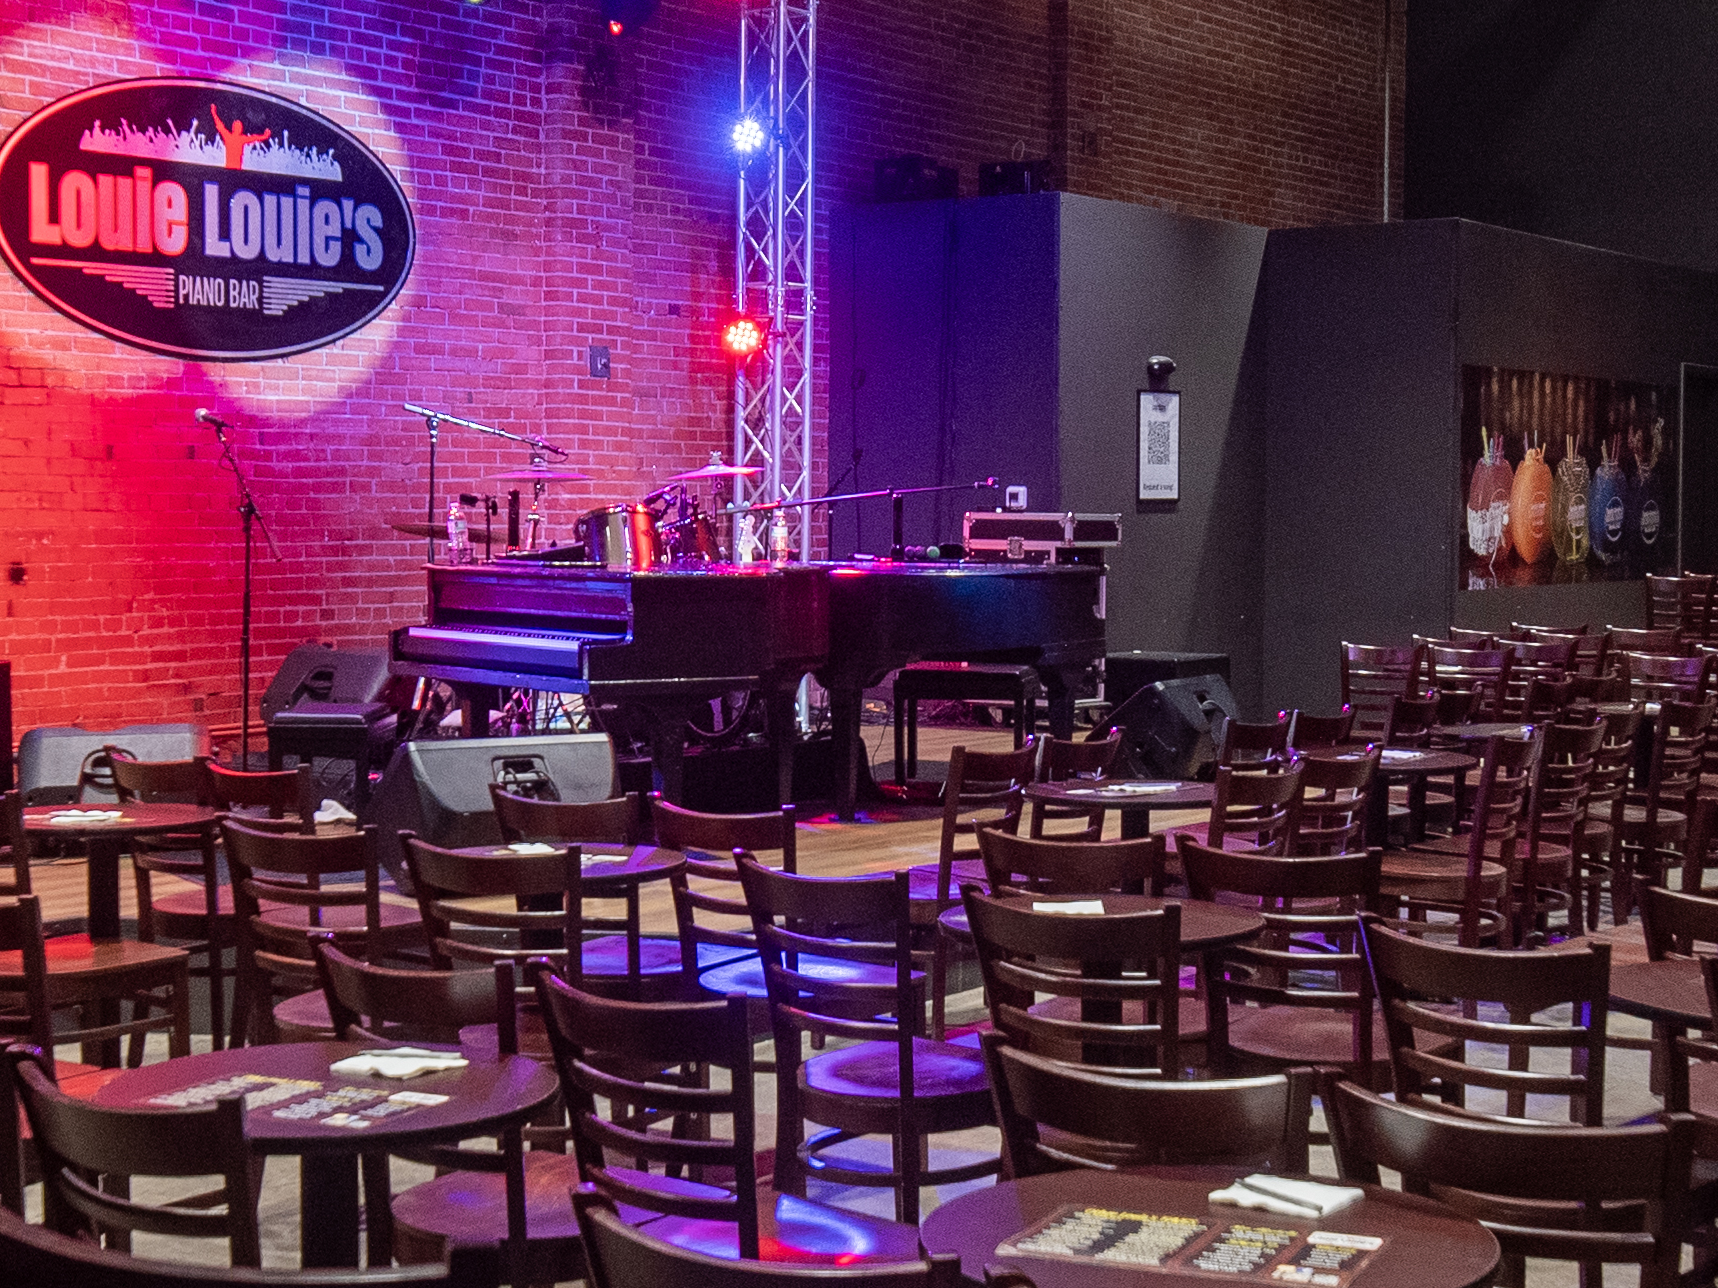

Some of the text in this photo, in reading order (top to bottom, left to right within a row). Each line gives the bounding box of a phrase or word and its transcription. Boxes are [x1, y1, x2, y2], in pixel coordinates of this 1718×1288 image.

[28, 161, 384, 272] Louie Louie's
[178, 274, 260, 310] PIANO BAR
